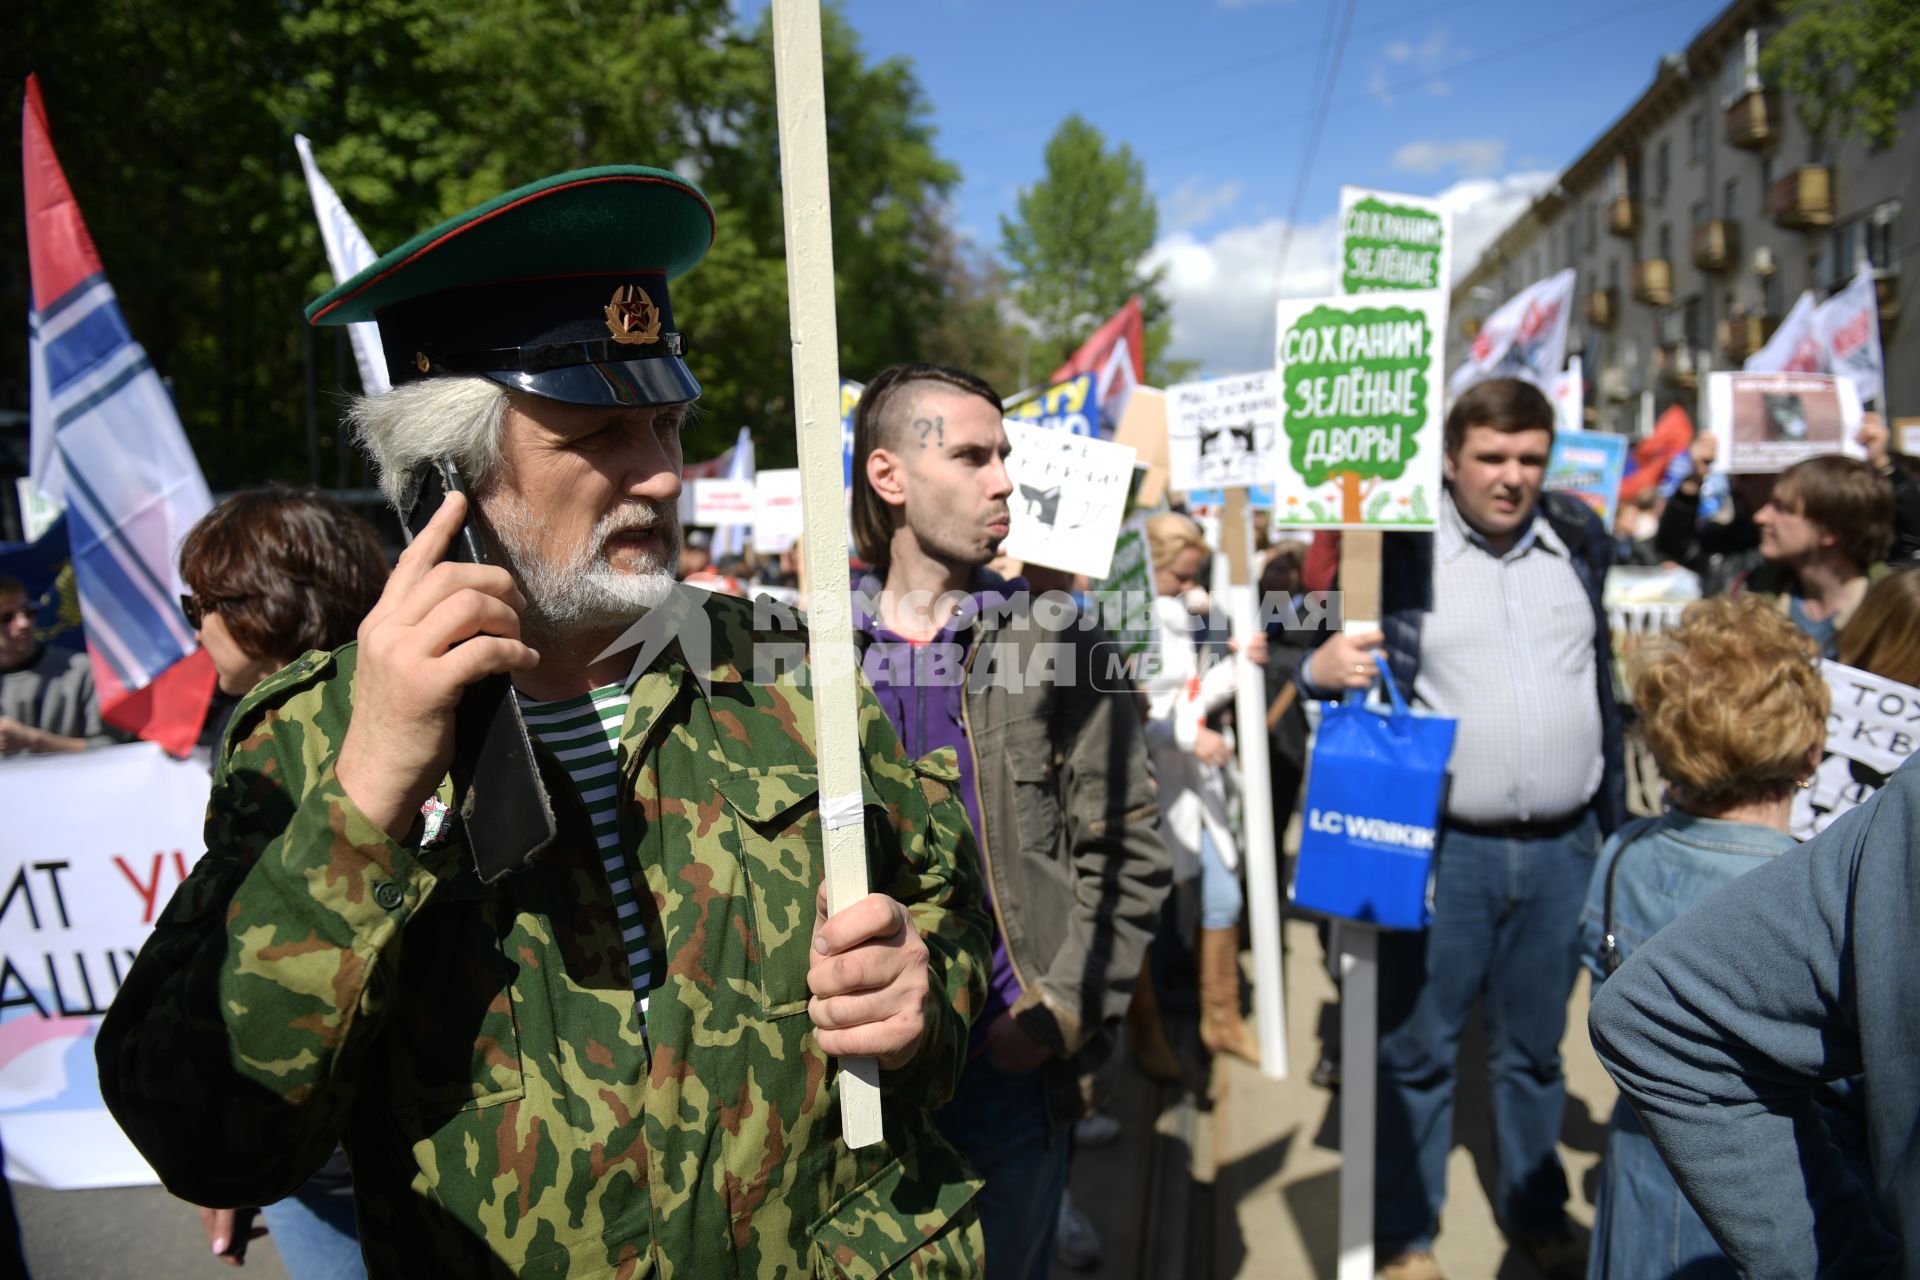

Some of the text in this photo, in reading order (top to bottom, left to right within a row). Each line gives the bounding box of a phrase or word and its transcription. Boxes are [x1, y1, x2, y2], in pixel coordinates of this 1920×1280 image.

[1284, 320, 1423, 365] СОХРАНИМ
[1293, 367, 1419, 418] ЗЕЛЁНЫЕ
[912, 415, 945, 449] ?!
[1304, 424, 1401, 470] ДВОРЫ
[1309, 808, 1344, 835] LC
[0, 950, 137, 1019] АШ
